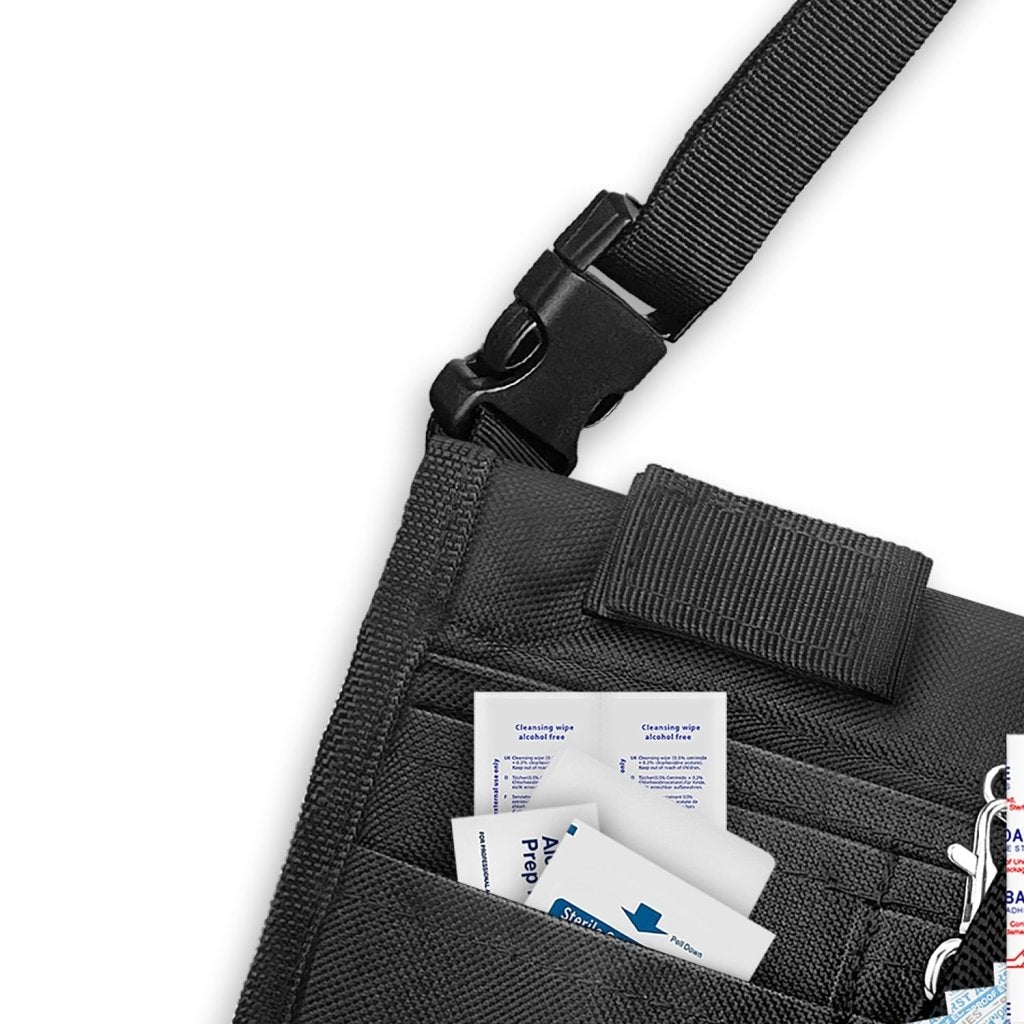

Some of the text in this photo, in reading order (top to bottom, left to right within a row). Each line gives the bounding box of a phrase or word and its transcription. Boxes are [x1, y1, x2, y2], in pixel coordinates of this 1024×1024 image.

[515, 724, 574, 732] Cleansing wipe
[642, 724, 700, 732] Cleansing wipe
[492, 758, 500, 774] only
[521, 839, 538, 884] Prep
[560, 906, 602, 932] Steril
